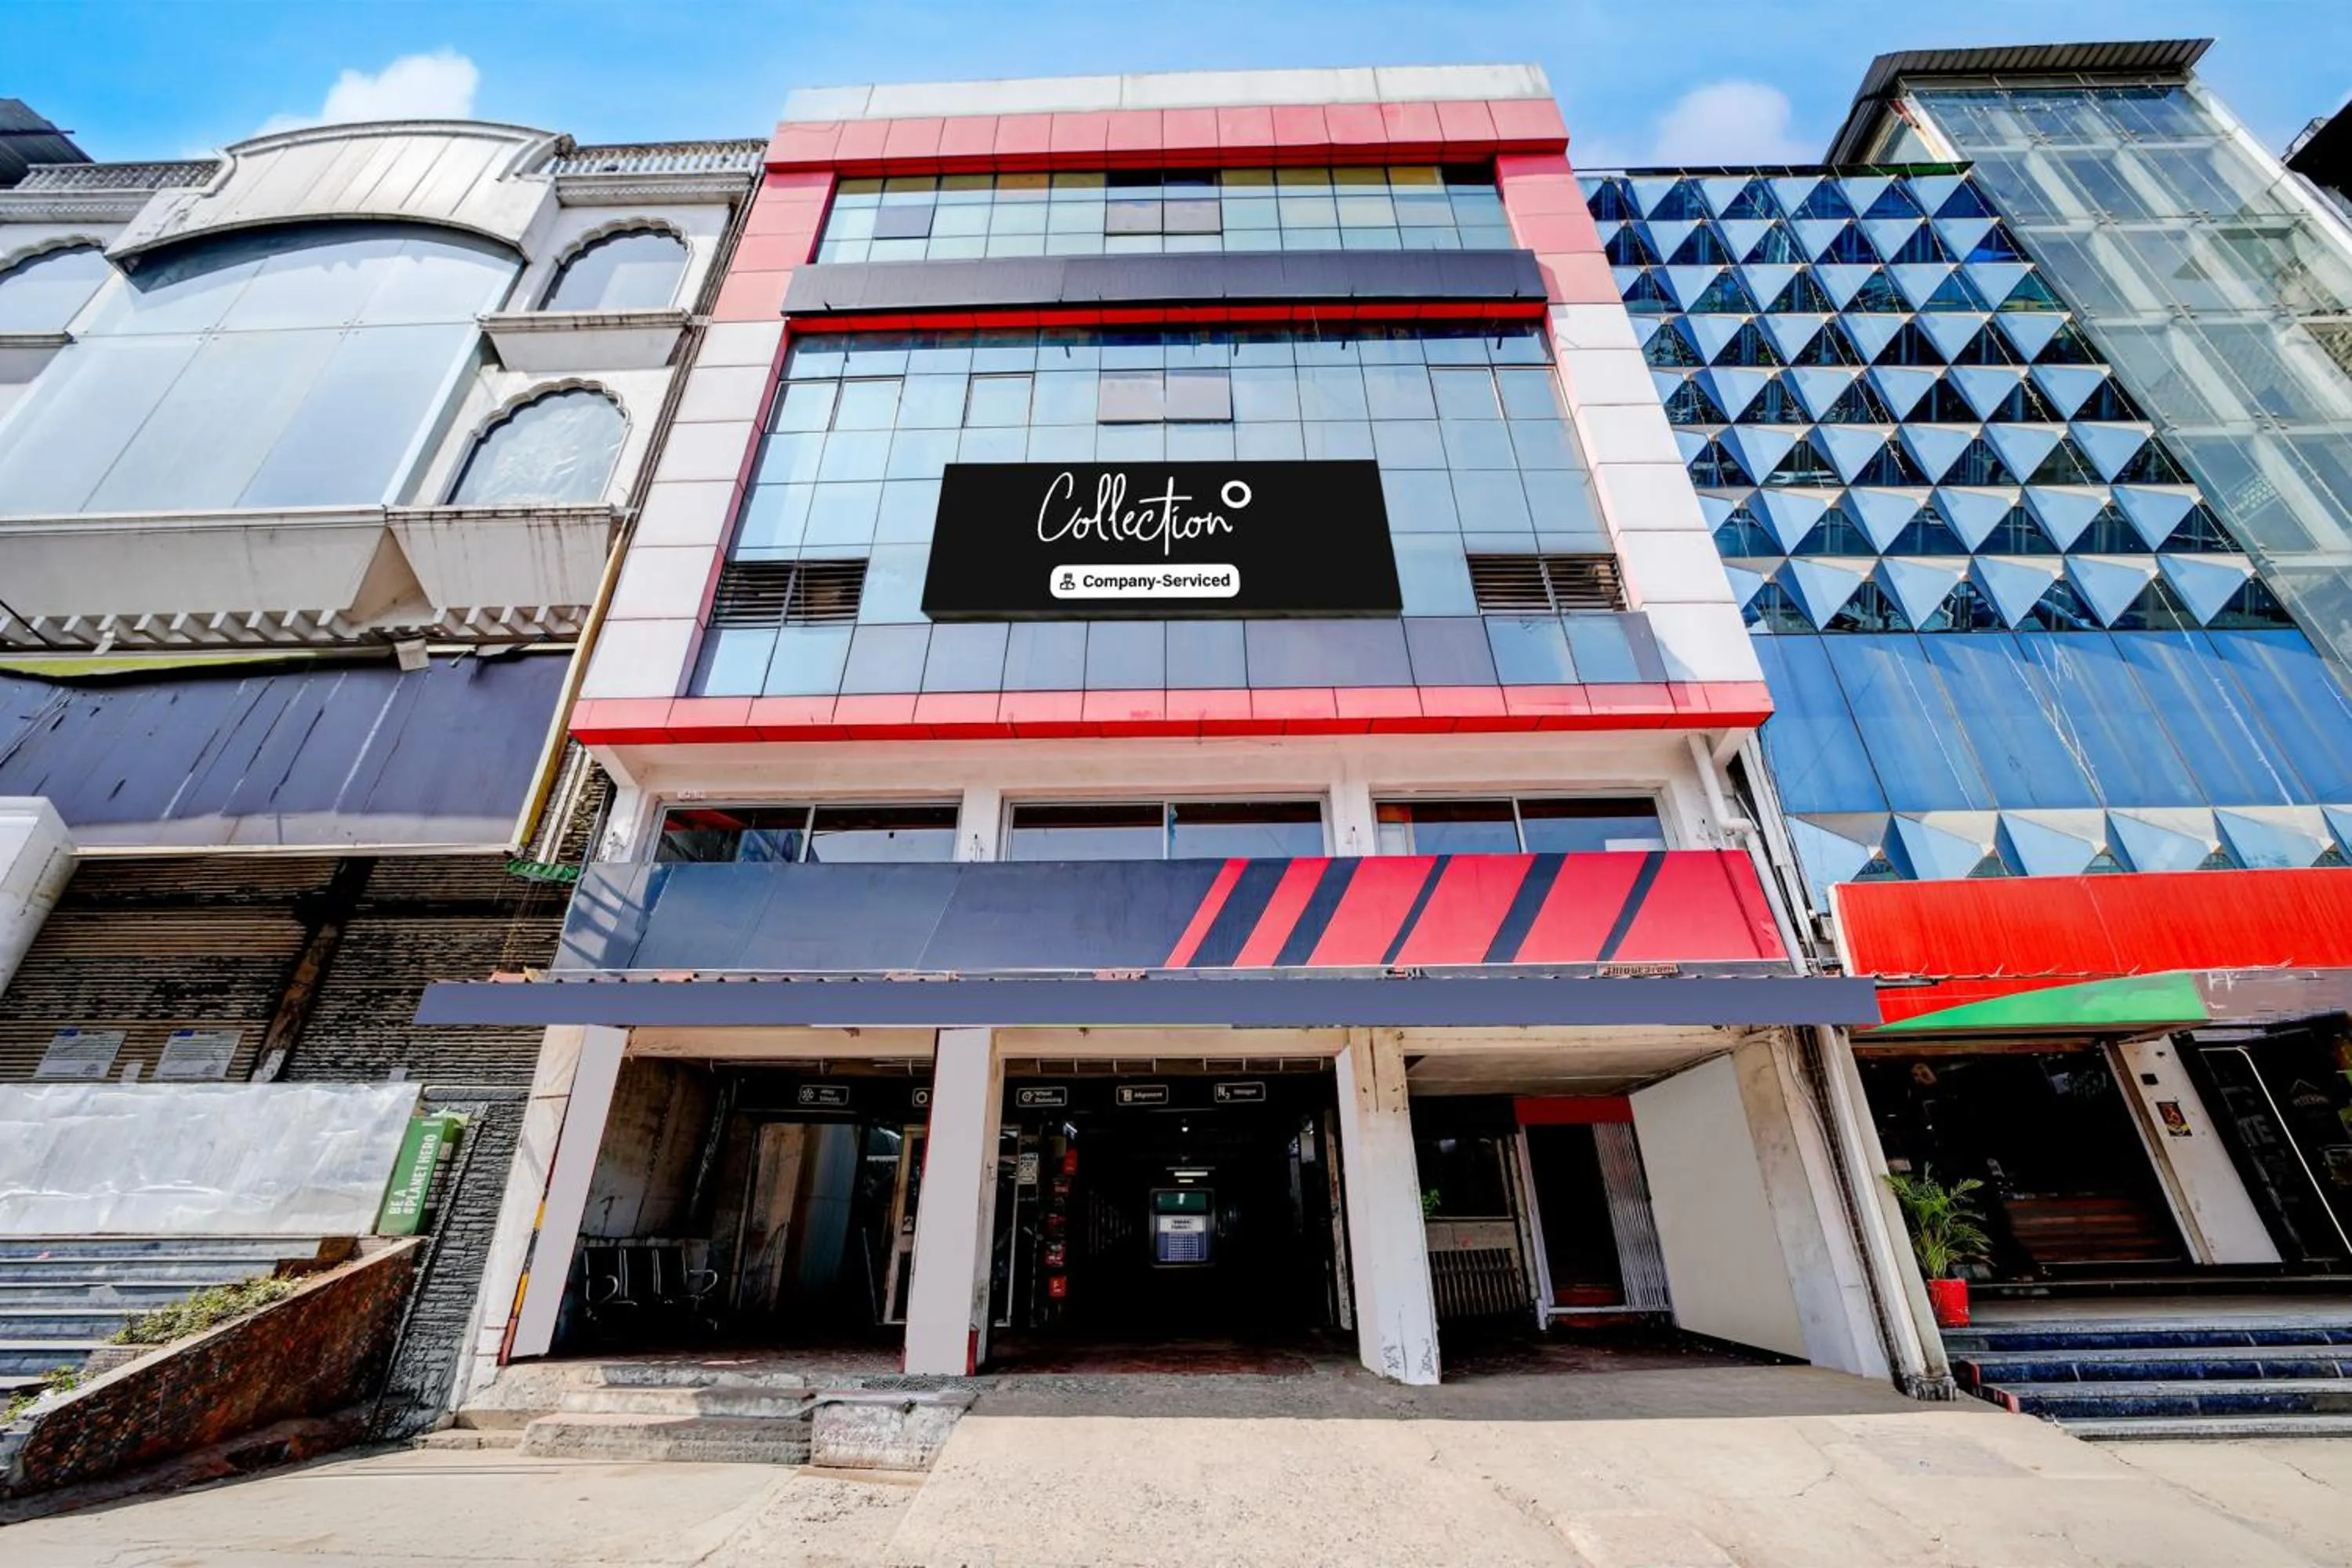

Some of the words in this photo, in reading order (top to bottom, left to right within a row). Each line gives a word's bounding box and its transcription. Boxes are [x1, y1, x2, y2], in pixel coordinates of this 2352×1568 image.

[1037, 472, 1233, 556] Collection
[1083, 573, 1230, 591] Company-Serviced
[403, 1165, 429, 1214] #PLANET
[417, 1134, 438, 1164] HERO
[389, 1200, 404, 1214] BE
